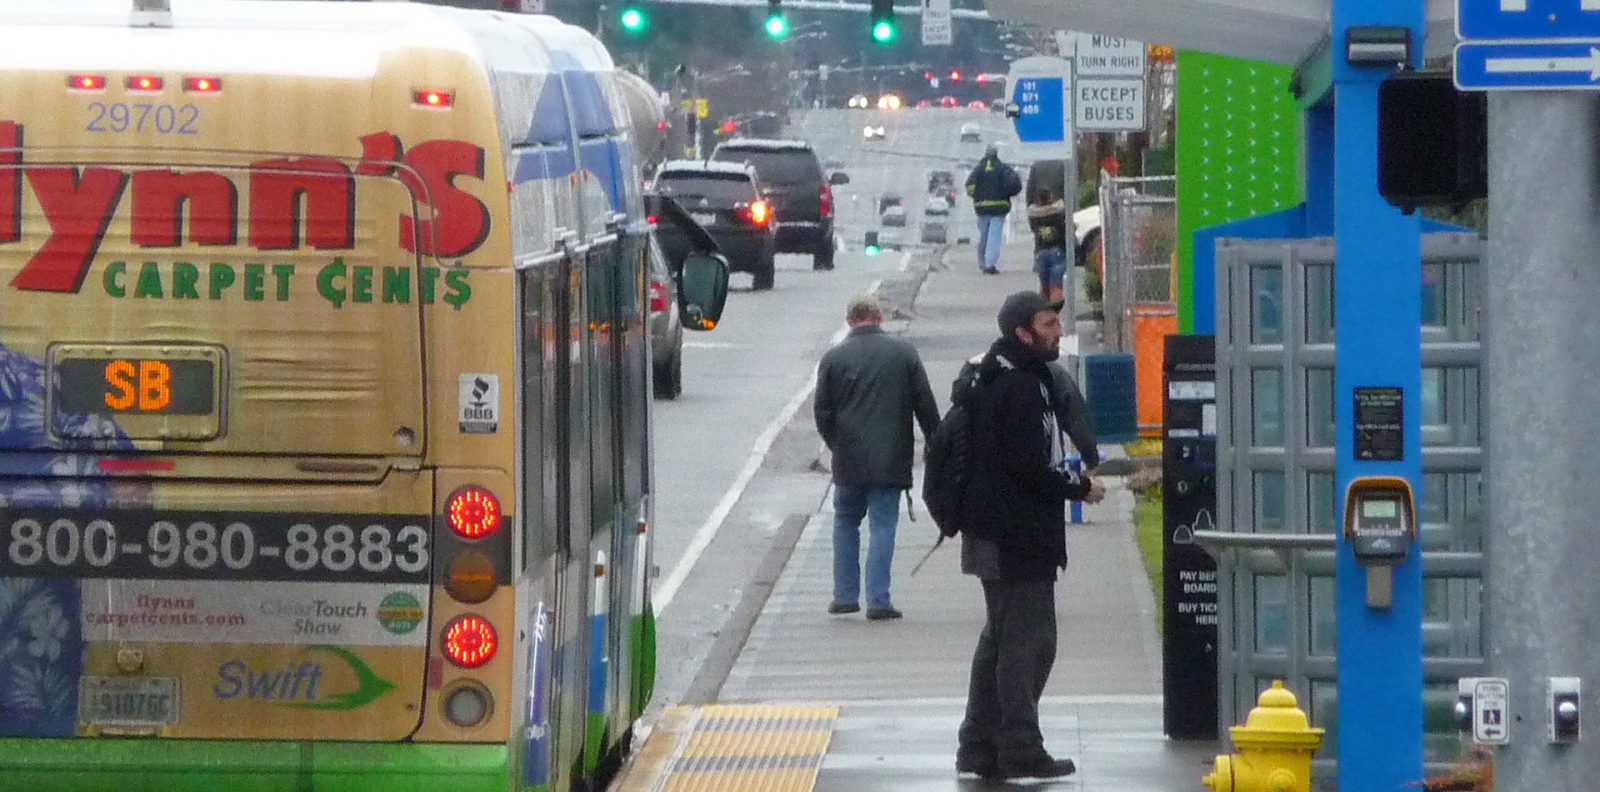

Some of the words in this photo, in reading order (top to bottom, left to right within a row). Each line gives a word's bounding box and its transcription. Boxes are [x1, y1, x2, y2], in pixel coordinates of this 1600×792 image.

[1092, 33, 1127, 48] MUST
[1081, 56, 1106, 67] TURN
[1110, 56, 1139, 67] RIGHT
[1081, 87, 1138, 101] EXCEPT
[86, 102, 199, 135] 29702
[1084, 106, 1135, 121] BUSES
[103, 262, 295, 302] CARPET
[104, 360, 172, 412] SB
[464, 408, 493, 420] BBB
[8, 518, 430, 574] 800-980-8883
[1180, 571, 1198, 581] PAY
[1183, 583, 1217, 594] BOARD
[1178, 602, 1198, 613] BUY
[294, 618, 342, 635] Shaw
[214, 660, 322, 699] Swift
